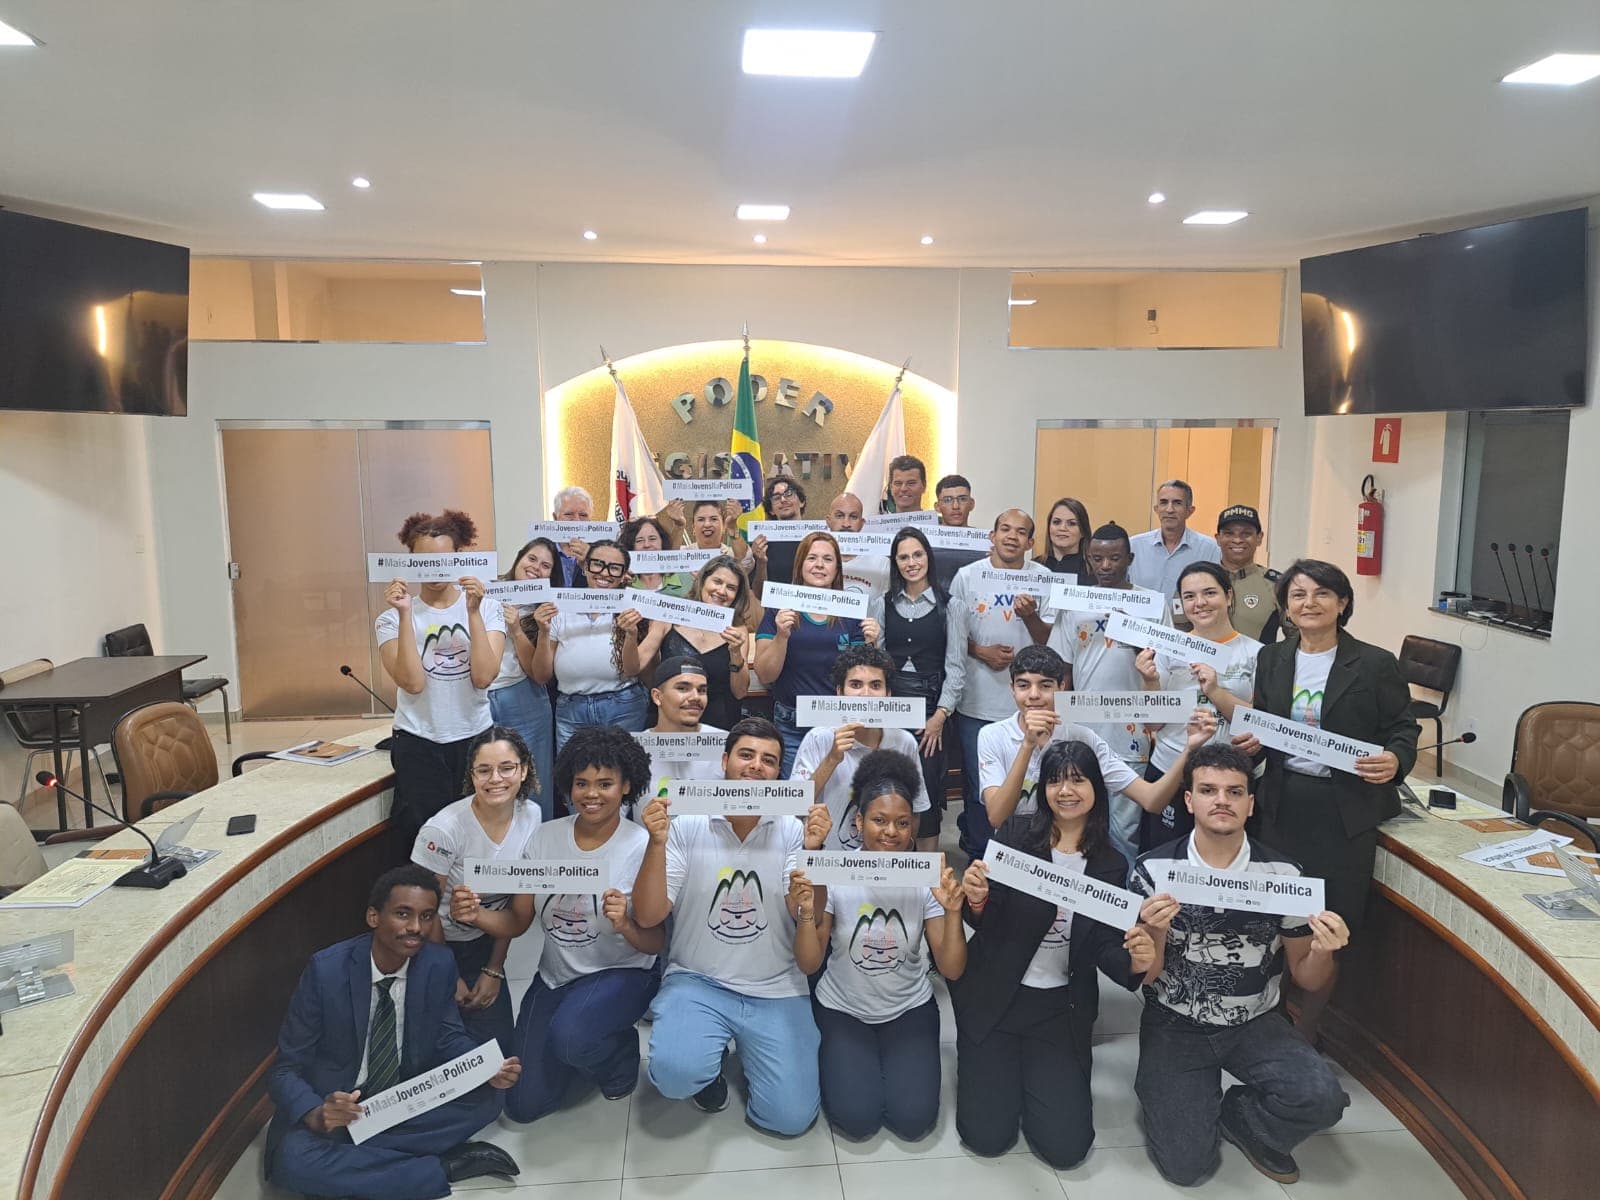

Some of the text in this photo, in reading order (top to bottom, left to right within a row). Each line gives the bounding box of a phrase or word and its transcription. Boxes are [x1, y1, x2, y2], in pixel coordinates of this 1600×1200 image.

[671, 373, 834, 427] PODER
[377, 557, 488, 568] #MaisJovensNaPolítica
[981, 570, 1065, 584] #MaisJovensNaPolítica
[770, 588, 861, 606] #MaisJovensNaPolítica
[1063, 588, 1151, 605] #MaisJovensNaPolítica
[631, 594, 725, 620] #MaisJovensNaPolítica
[1121, 618, 1217, 656] #MaisJovensNaPolítica
[811, 700, 911, 713] #MaisJovensNaPolítica
[1070, 695, 1181, 707] #MaisJovensNaPolítica
[678, 786, 805, 798] #MaisJovensNaPolítica
[474, 864, 599, 877] #MaisJovensNaPolítica
[806, 856, 931, 870] #MaisJovensNaPolítica
[995, 850, 1129, 910] #MaisJovensNaPolítica
[1167, 870, 1312, 897] #MaisJovensNaPolítica
[364, 1054, 484, 1117] #MaisJovensNaPolítica
